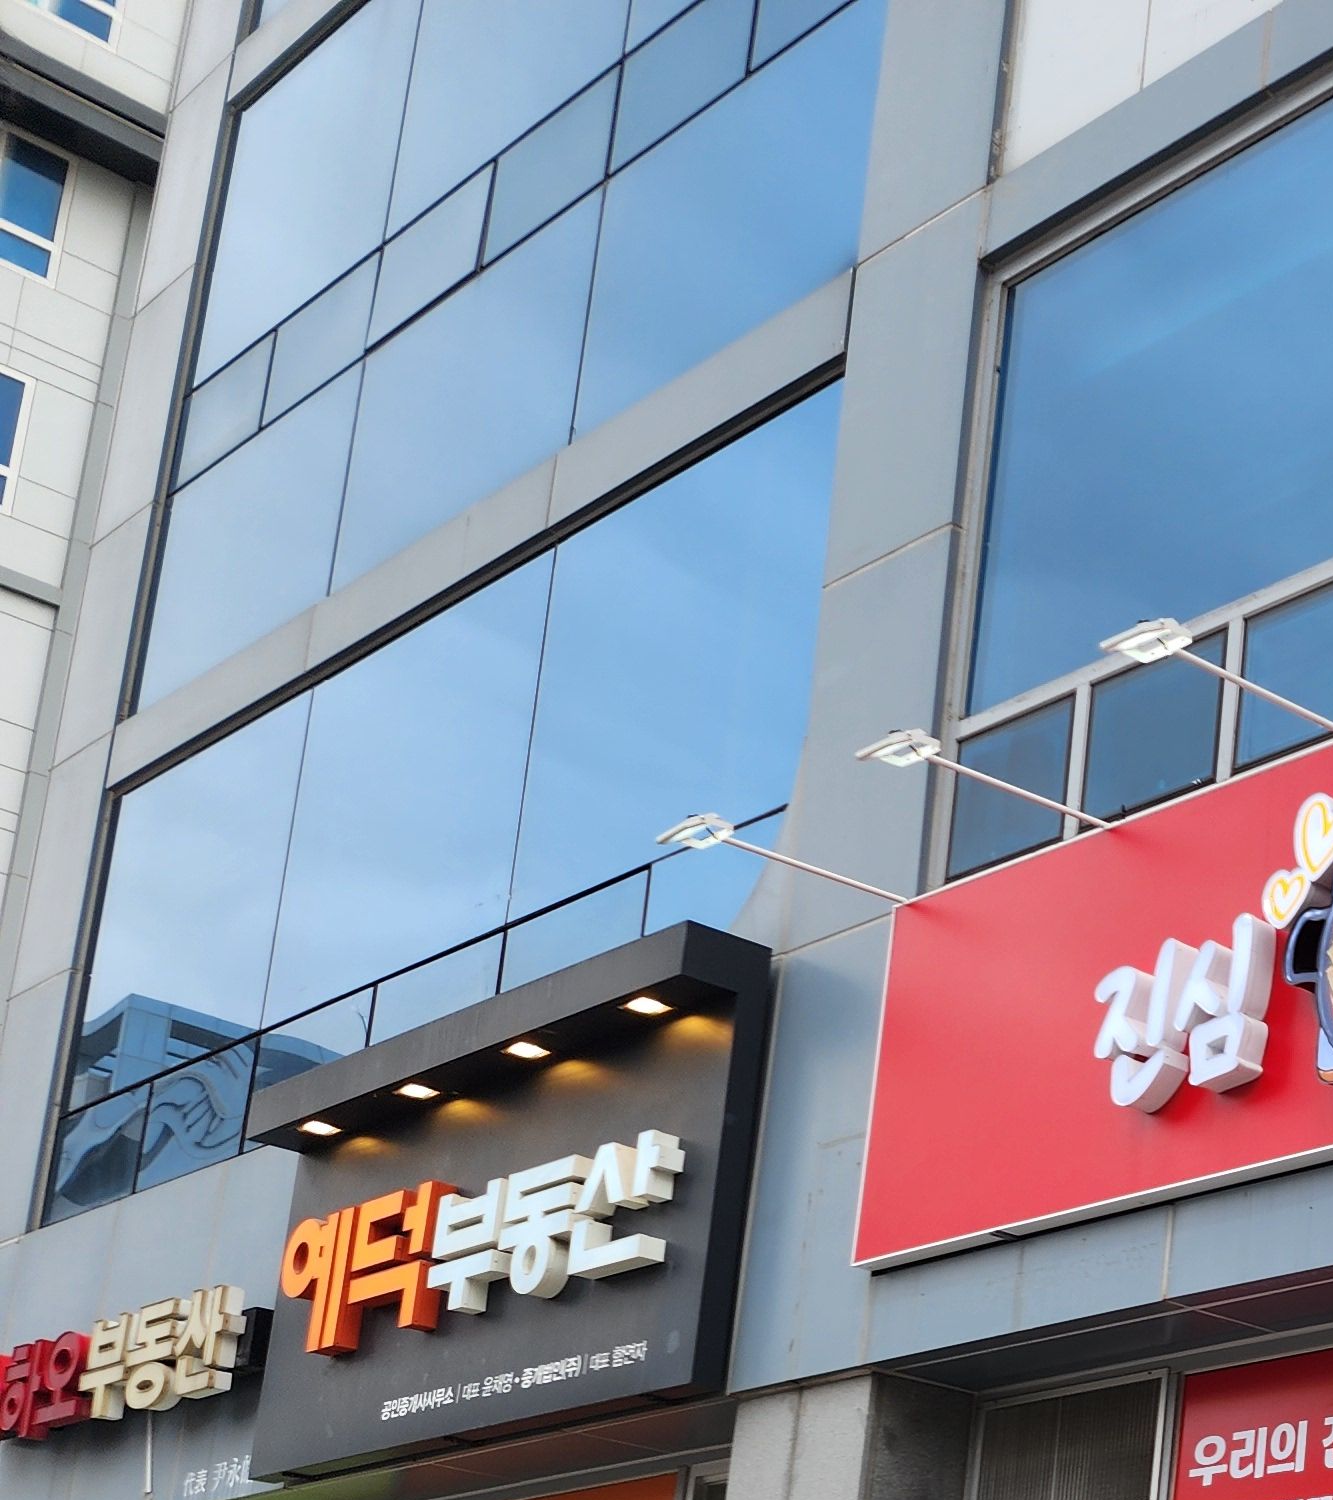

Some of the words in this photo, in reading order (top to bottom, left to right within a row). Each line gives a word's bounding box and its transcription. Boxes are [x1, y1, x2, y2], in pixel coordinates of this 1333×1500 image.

[1090, 909, 1270, 1114] 진심
[280, 1129, 686, 1356] 예덕부동산
[1191, 1422, 1306, 1490] 우리의
